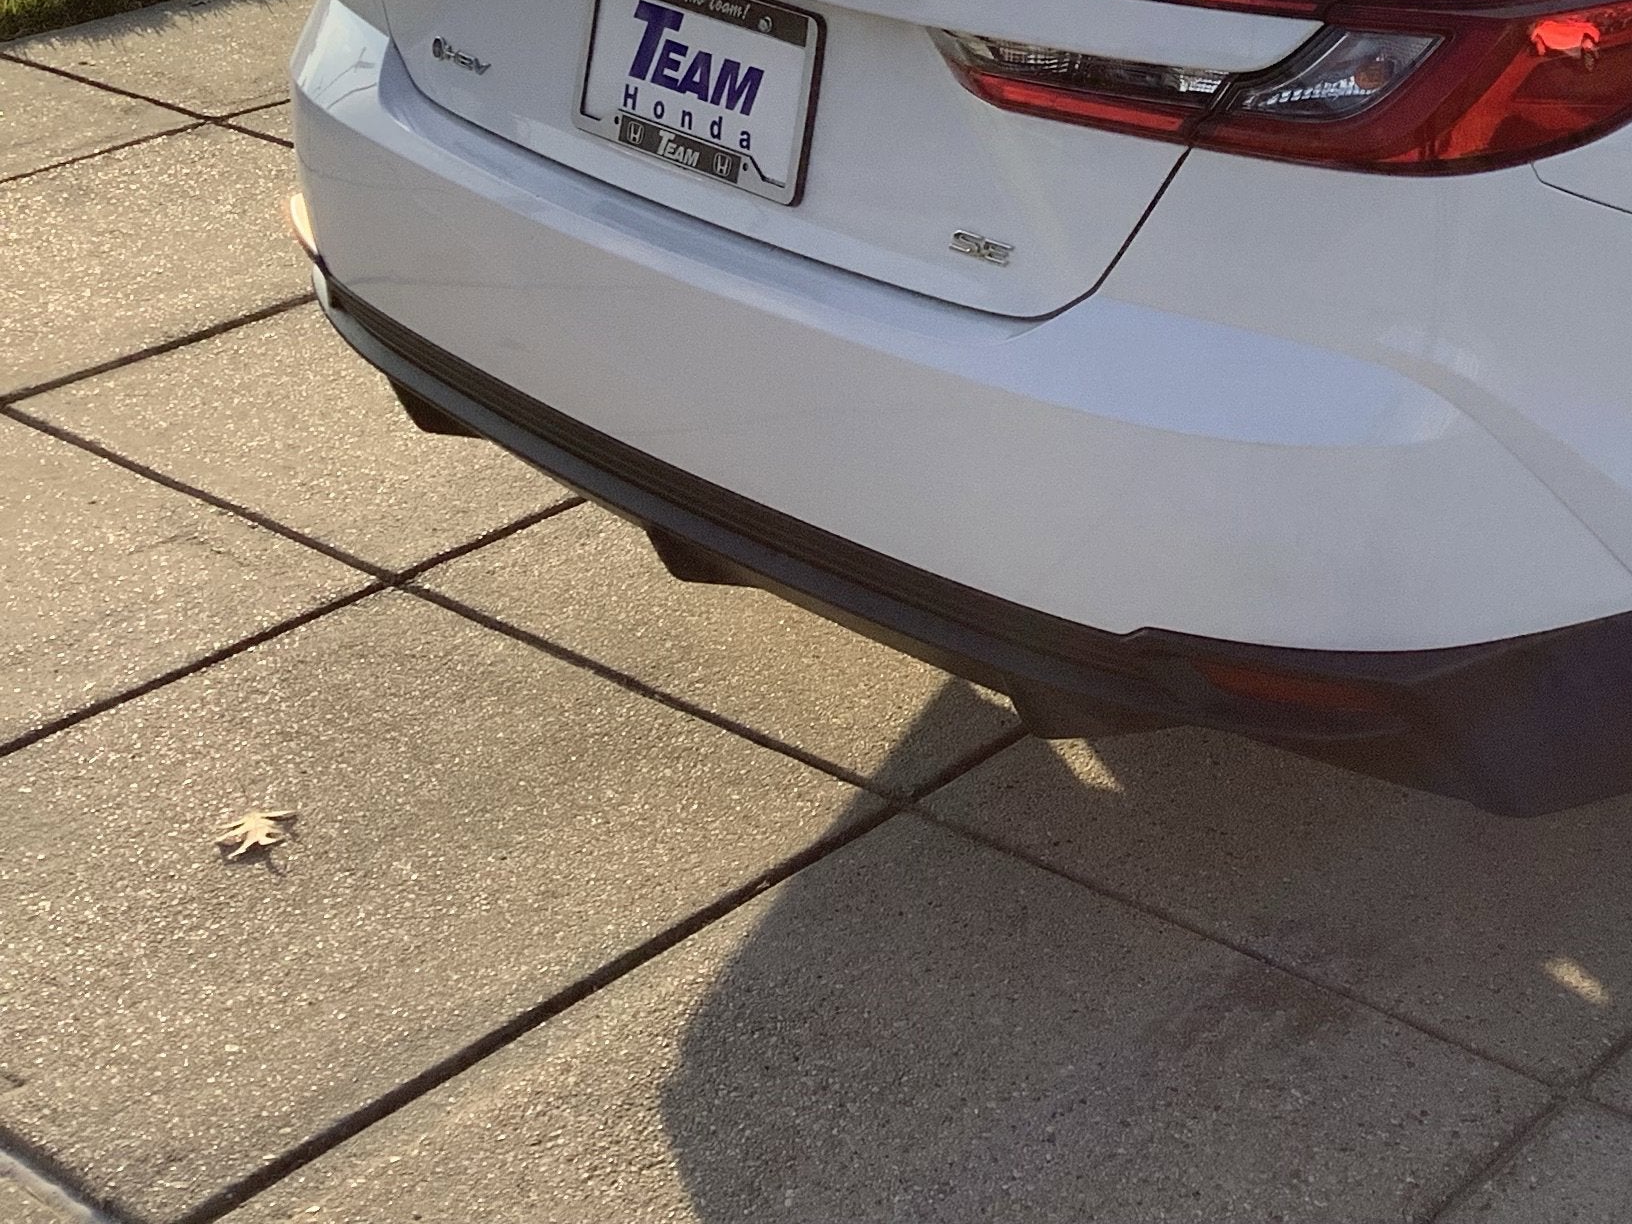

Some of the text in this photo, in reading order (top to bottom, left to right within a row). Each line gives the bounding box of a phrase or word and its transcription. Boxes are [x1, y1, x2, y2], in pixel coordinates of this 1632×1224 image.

[628, 0, 765, 117] TEAM
[622, 84, 750, 150] Honda
[657, 130, 700, 168] TEAM
[949, 229, 1015, 267] SE
